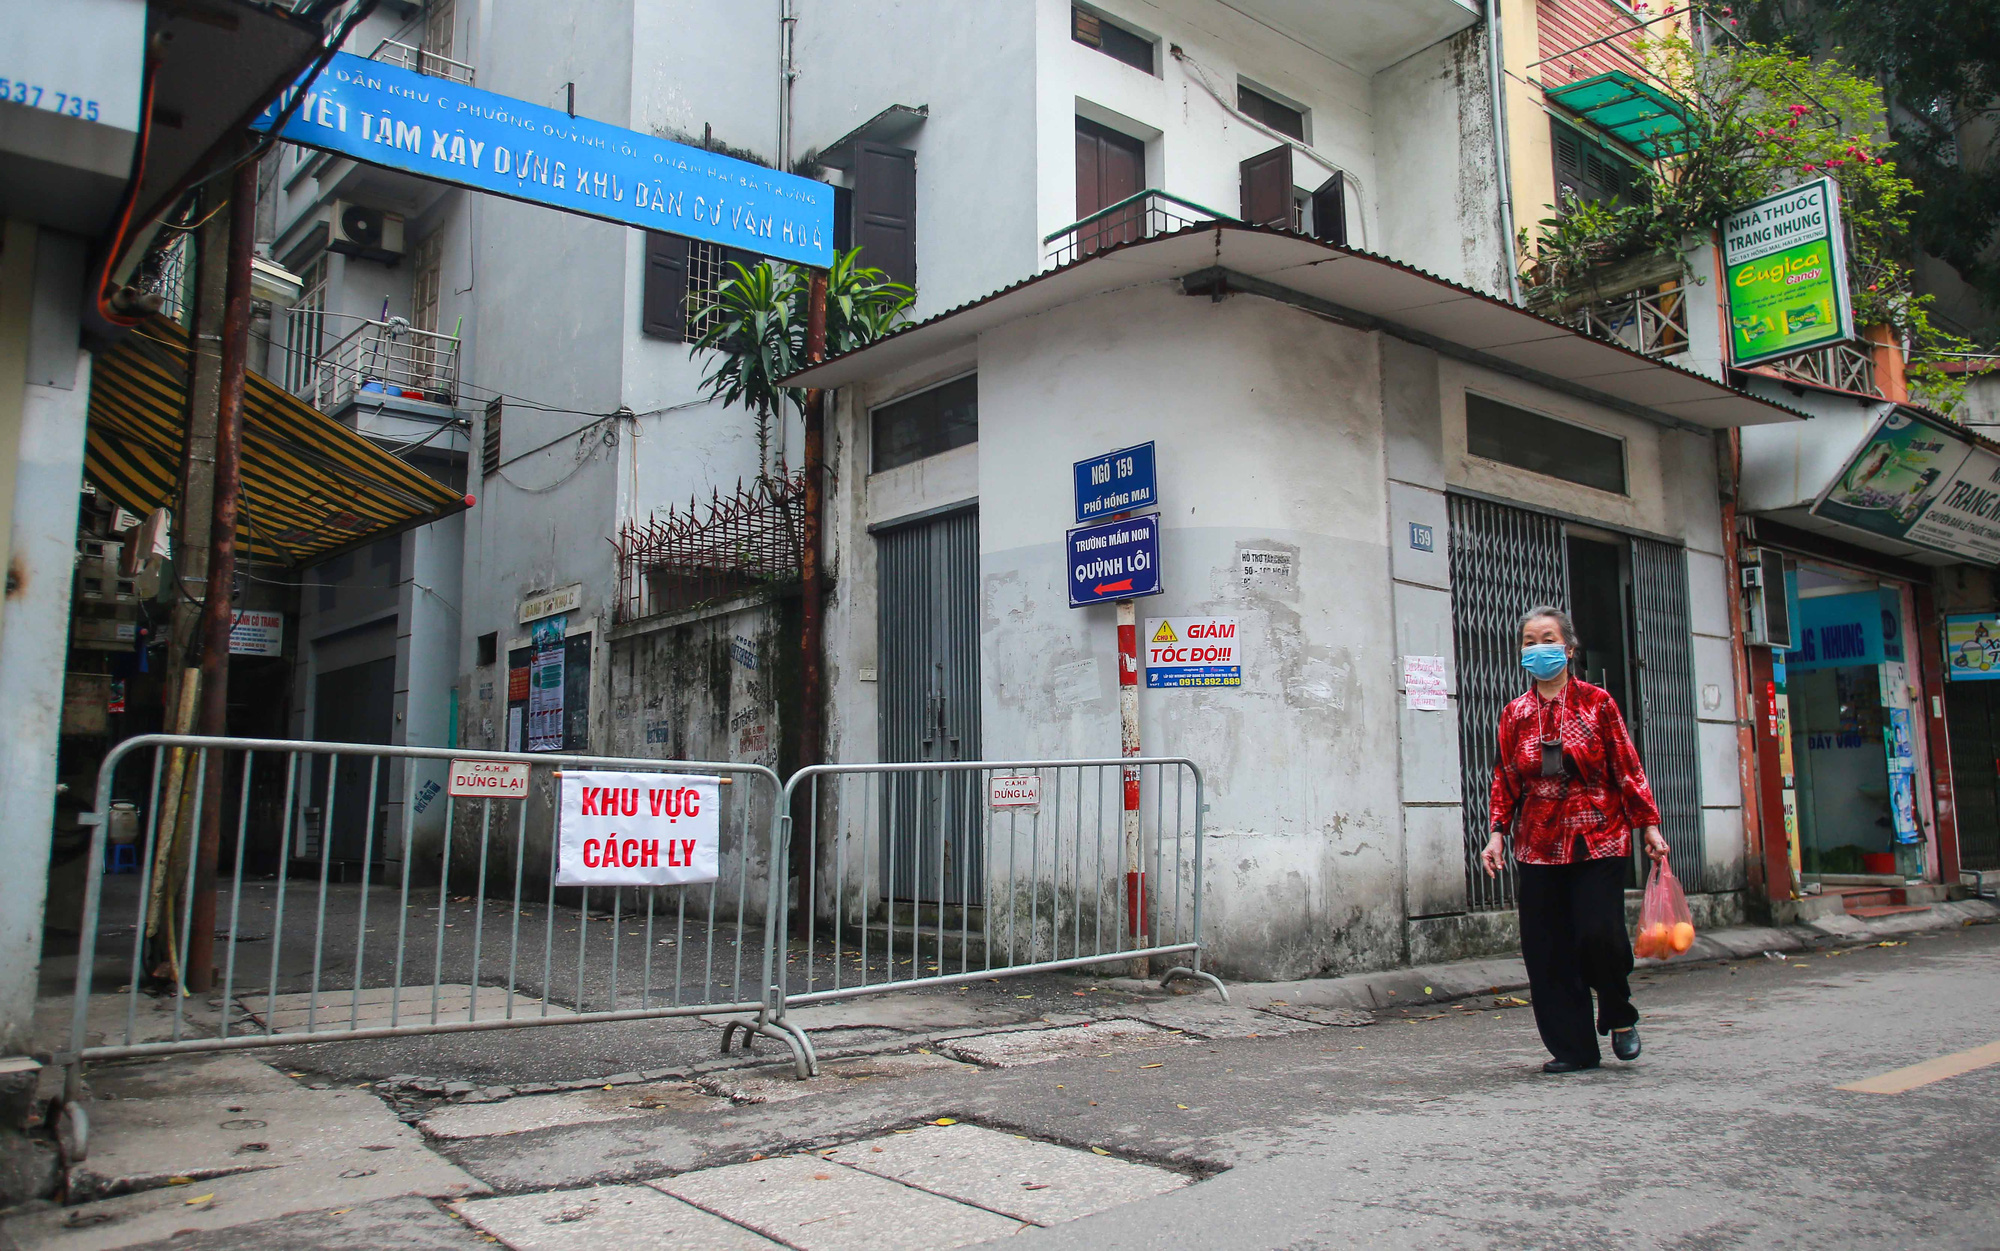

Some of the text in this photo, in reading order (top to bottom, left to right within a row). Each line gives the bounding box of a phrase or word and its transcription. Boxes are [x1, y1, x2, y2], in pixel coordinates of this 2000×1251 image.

[55, 91, 100, 122] 735
[337, 70, 382, 92] DÂN
[388, 84, 430, 103] KHU
[438, 97, 450, 109] C
[457, 101, 535, 131] PHƯỜNG
[361, 109, 422, 155] TÂM
[431, 129, 486, 169] XÂY
[494, 146, 567, 189] DỰNG
[575, 167, 624, 202] KHU
[635, 179, 684, 218] DÂN
[693, 195, 725, 226] CƯ
[731, 201, 773, 239] VĂN
[1729, 193, 1819, 233] NHÀ THUỐC
[1728, 212, 1821, 252] TRANG NHUNG
[1735, 254, 1821, 287] Eugica
[1786, 268, 1822, 285] Candy
[1091, 456, 1134, 486] NGÕ 159
[1084, 487, 1150, 514] PHỐ HỒNG MAI
[1942, 479, 1998, 517] TRANG
[1075, 527, 1150, 552] TRƯỜNG MẦM NON
[1412, 527, 1431, 547] 159
[1075, 549, 1151, 583] QUỲNH LÔI
[1187, 620, 1236, 639] GIẢM
[1821, 623, 1865, 660] NHUNG
[1150, 643, 1232, 664] TỐC ĐỘ!!!
[1179, 678, 1241, 686] 0915.892.689
[455, 771, 524, 791] DỪNG LẠI
[474, 764, 509, 773] C.A.H.N
[581, 786, 701, 824] KHU VỰC
[994, 786, 1037, 800] DỪNG LẠI
[582, 832, 697, 868] CÁCH LY
